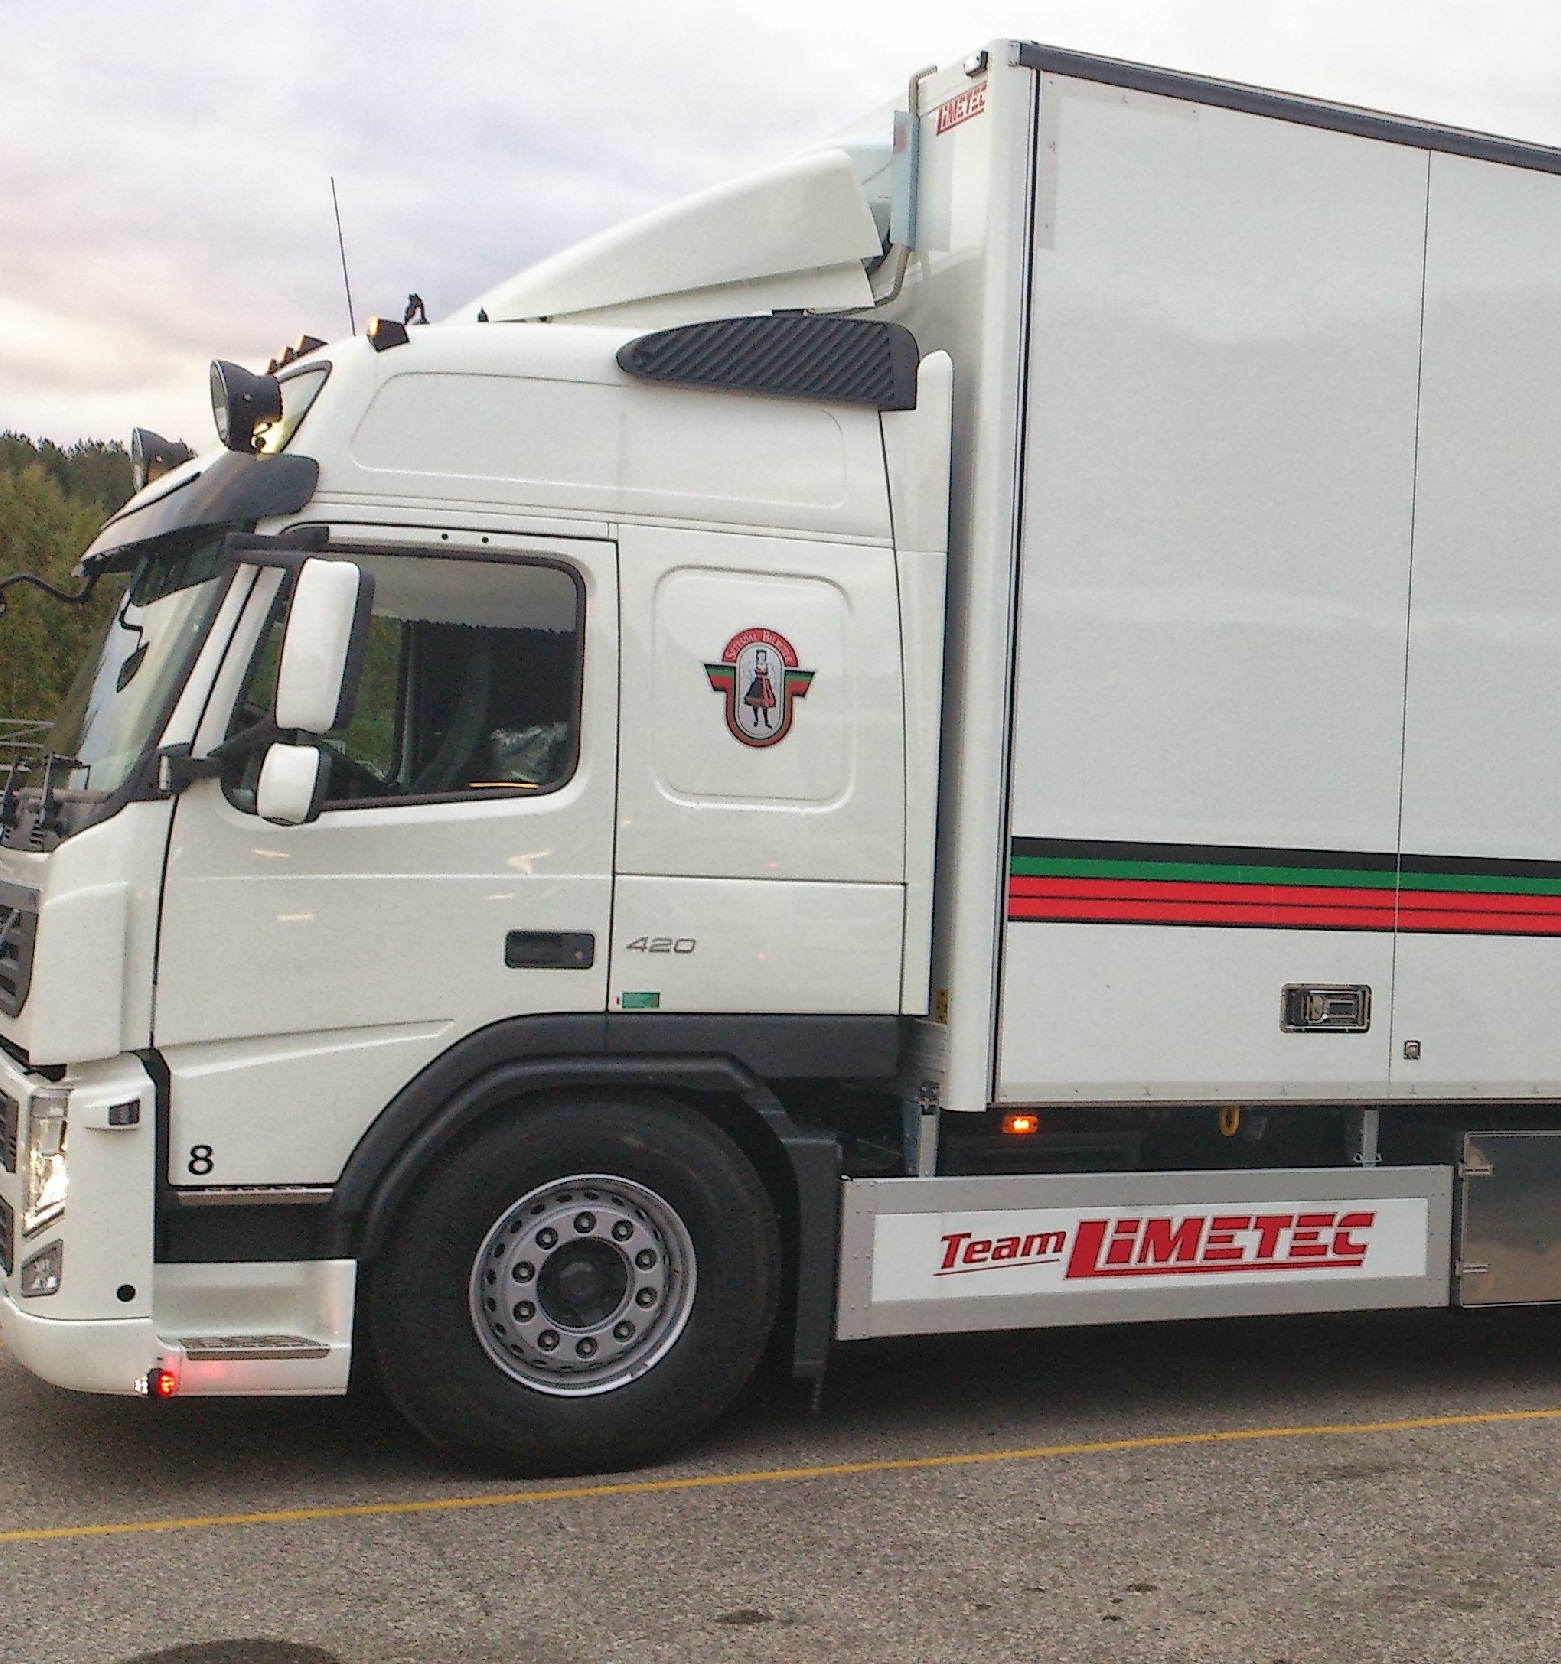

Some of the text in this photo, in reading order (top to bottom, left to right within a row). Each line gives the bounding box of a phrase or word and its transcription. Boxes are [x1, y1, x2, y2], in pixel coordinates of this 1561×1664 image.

[625, 936, 697, 953] 420
[188, 1145, 213, 1175] 8
[940, 1230, 1067, 1270] Team
